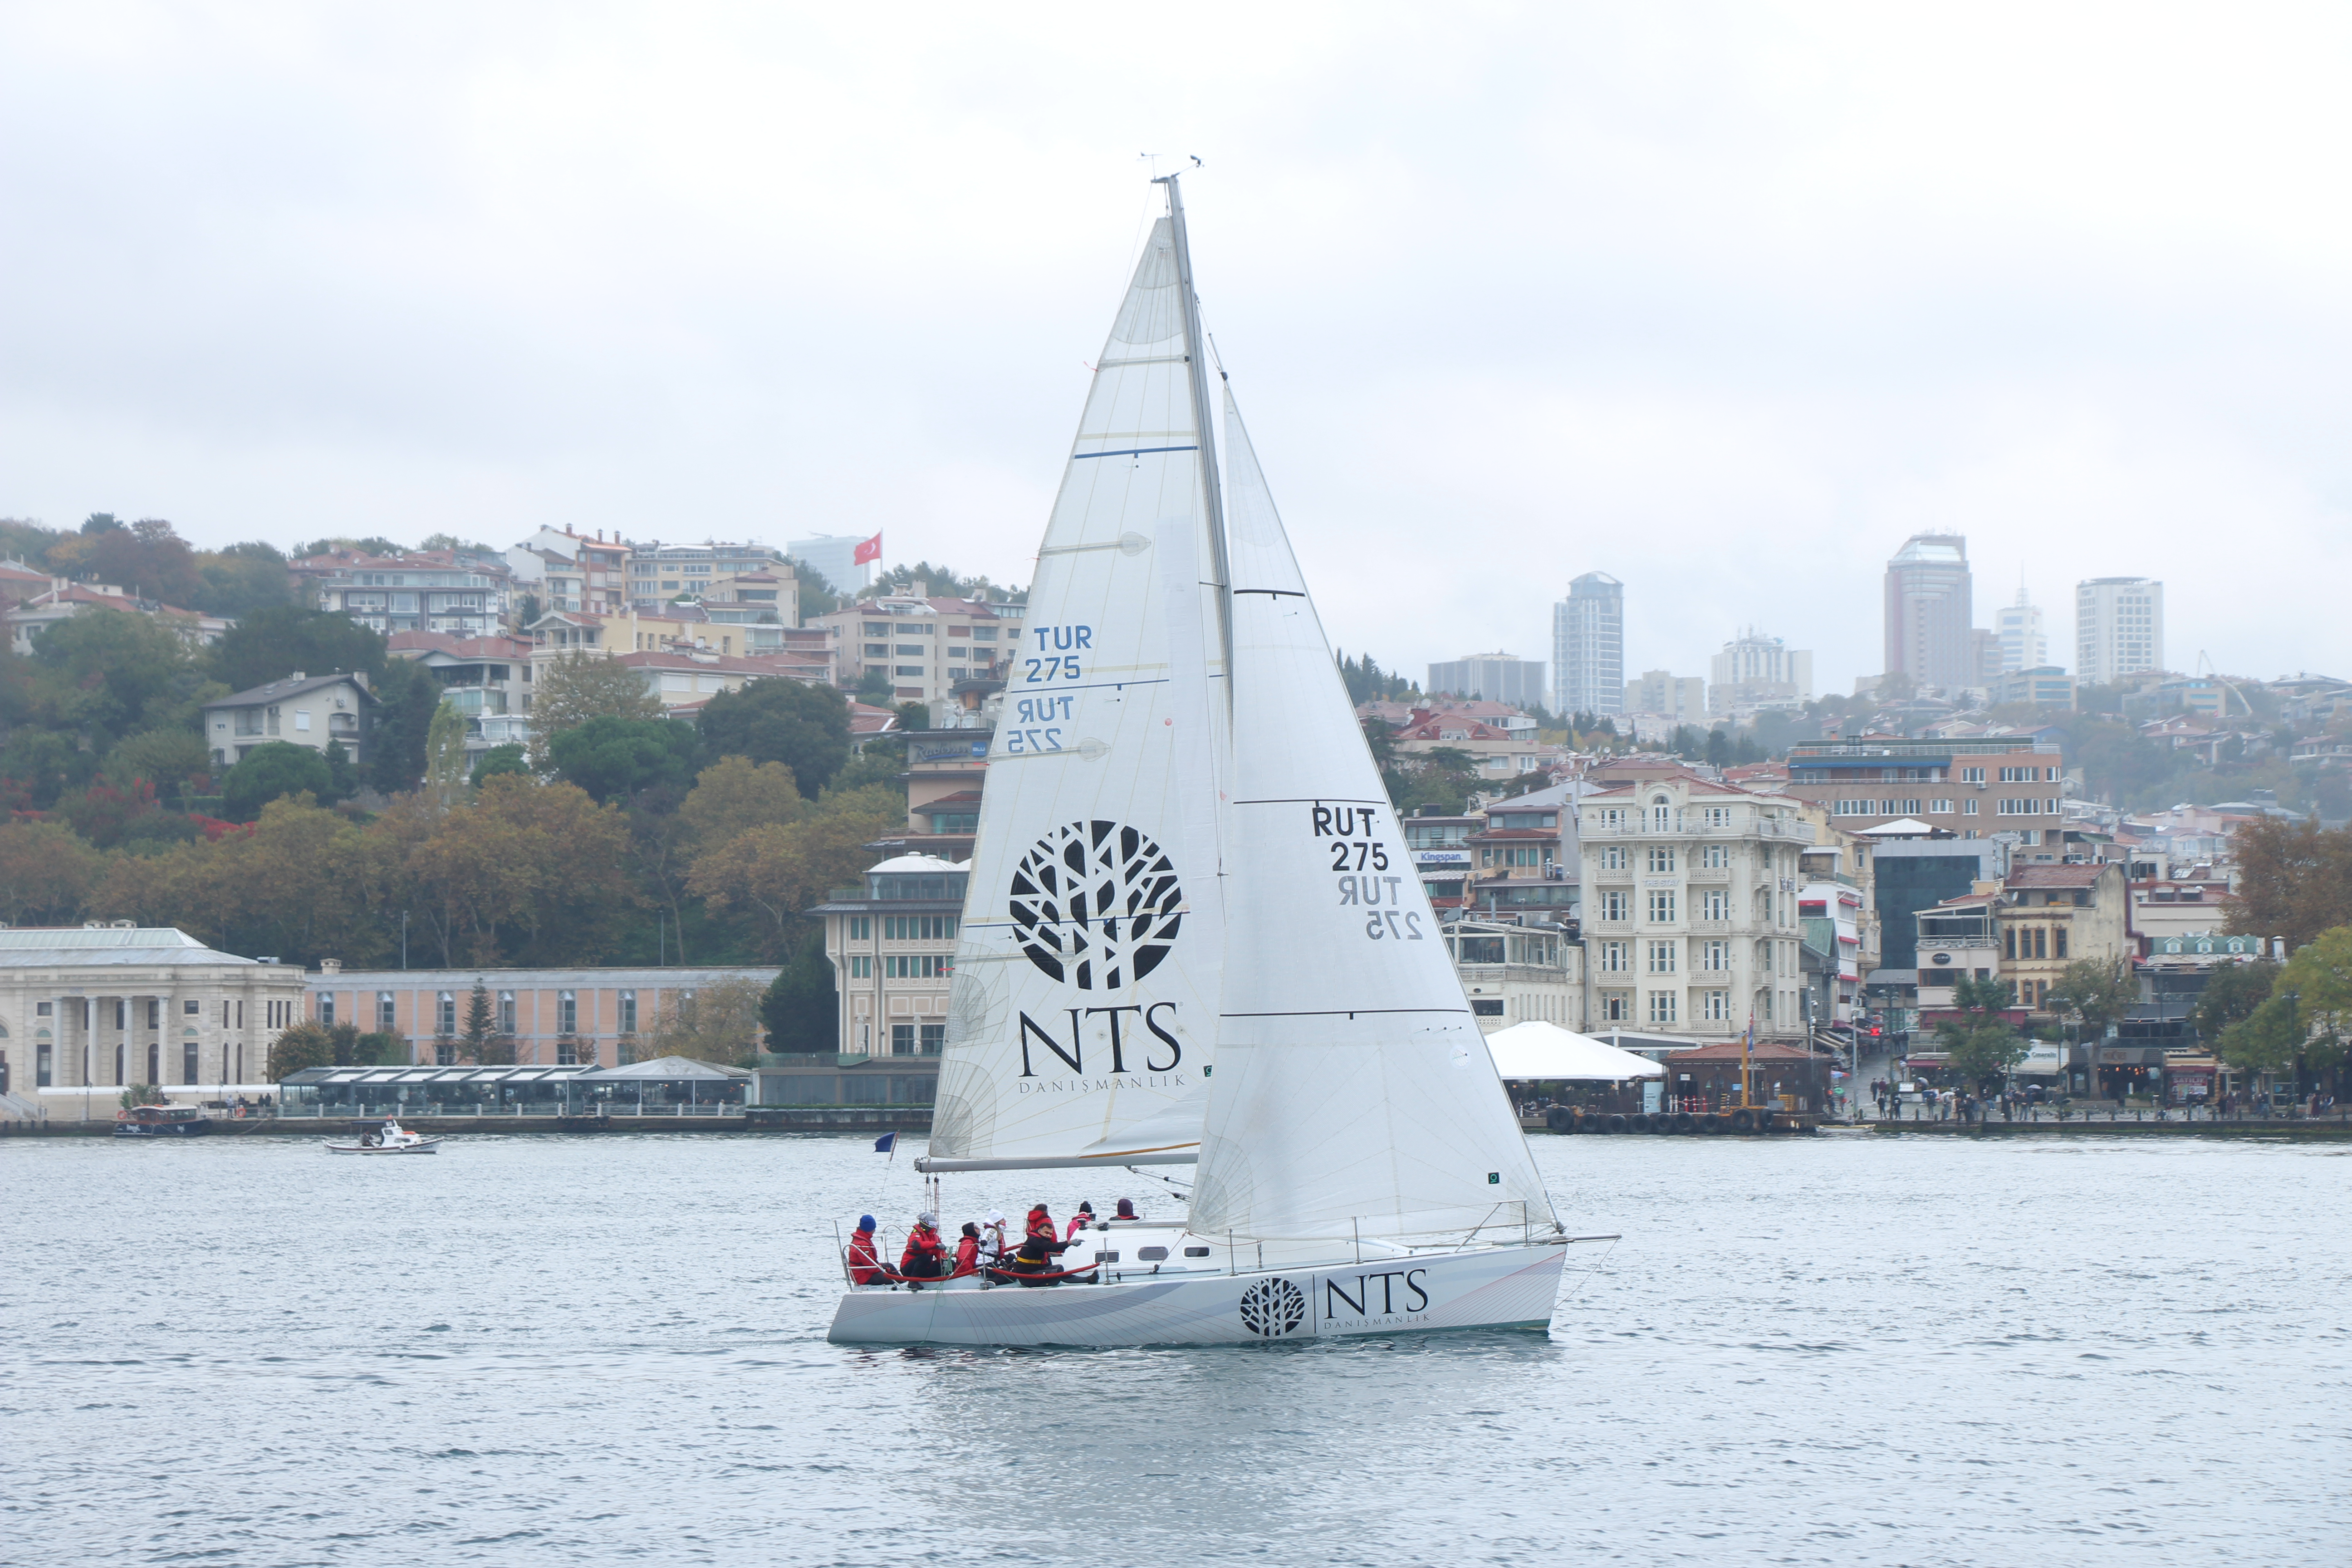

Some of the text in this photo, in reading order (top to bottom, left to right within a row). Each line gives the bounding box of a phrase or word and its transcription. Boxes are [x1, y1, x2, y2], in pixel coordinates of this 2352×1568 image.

[1034, 625, 1092, 651] TUR
[1025, 656, 1080, 682] 275
[1312, 807, 1375, 836] RUT
[1331, 842, 1389, 871] 275
[1421, 852, 1461, 862] Kingspan
[1018, 1002, 1181, 1077] NTS
[1019, 1074, 1186, 1094] DANIŞMANLIK
[1324, 1269, 1428, 1319] NTS
[1324, 1313, 1430, 1329] DANIŞMANLIK
